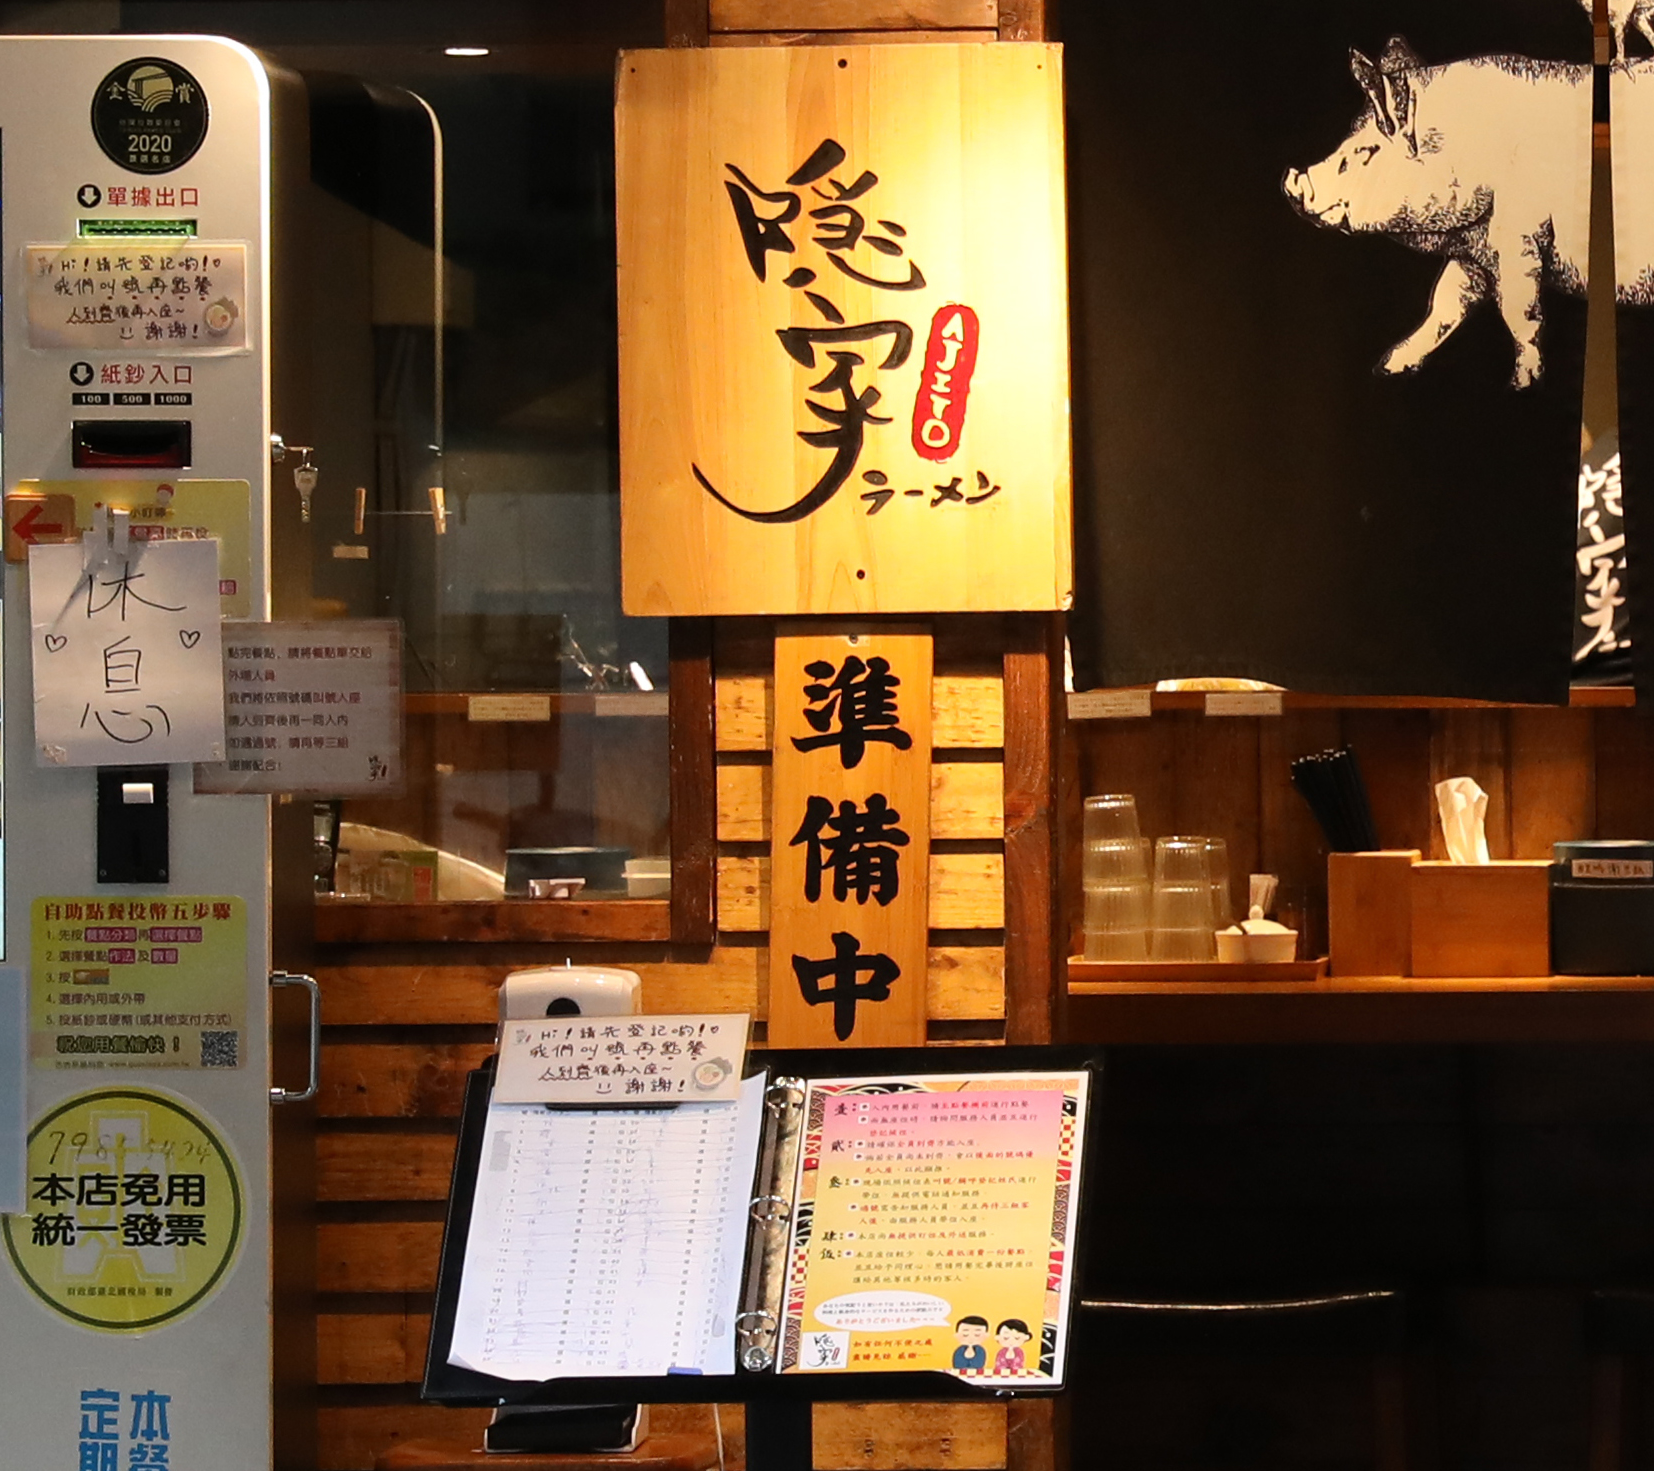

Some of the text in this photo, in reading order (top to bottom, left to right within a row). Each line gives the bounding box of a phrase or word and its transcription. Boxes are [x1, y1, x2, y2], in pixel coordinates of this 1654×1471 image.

[106, 81, 126, 101] 金
[128, 134, 172, 153] 2020
[107, 186, 199, 208] 單據出口
[100, 363, 192, 385] 紙鈔入口
[920, 312, 965, 448] AJITO
[80, 395, 188, 404] 100 500 1000
[861, 470, 1001, 515] ラーメン
[789, 655, 913, 1041] 準備中
[44, 902, 232, 921] 自助點餐投幣五步驟
[31, 1172, 206, 1207] 本店免用
[31, 1212, 208, 1248] 統一發票
